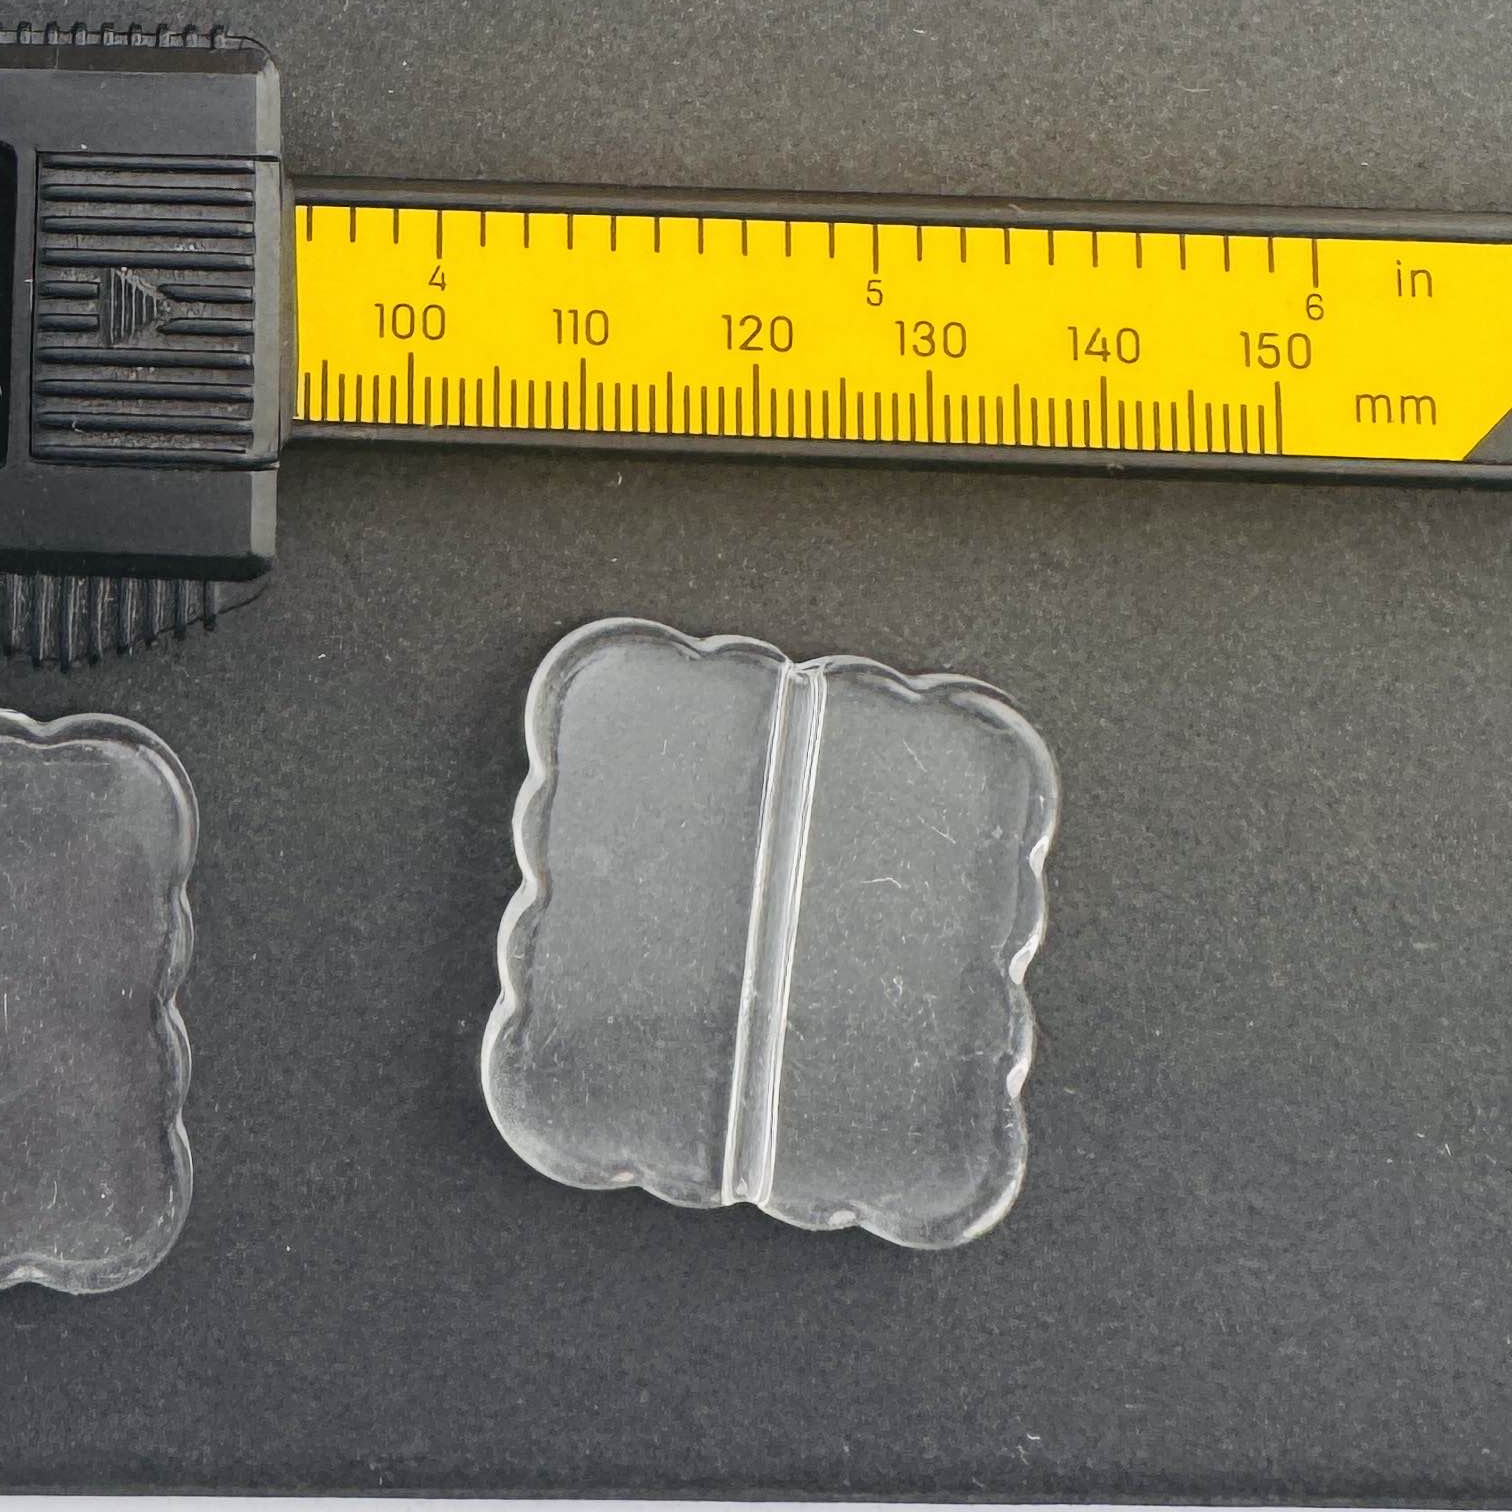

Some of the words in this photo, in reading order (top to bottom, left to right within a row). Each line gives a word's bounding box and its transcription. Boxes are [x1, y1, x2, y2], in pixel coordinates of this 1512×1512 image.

[428, 265, 447, 292] 4
[866, 279, 883, 307] 5
[1306, 293, 1324, 321] 6
[1396, 260, 1433, 298] in
[374, 303, 446, 341] 100
[552, 308, 609, 346] 110
[721, 314, 794, 353] 120
[895, 320, 967, 359] 130
[1067, 326, 1140, 364] 140
[1239, 331, 1311, 370] 150
[1355, 393, 1436, 425] mm
